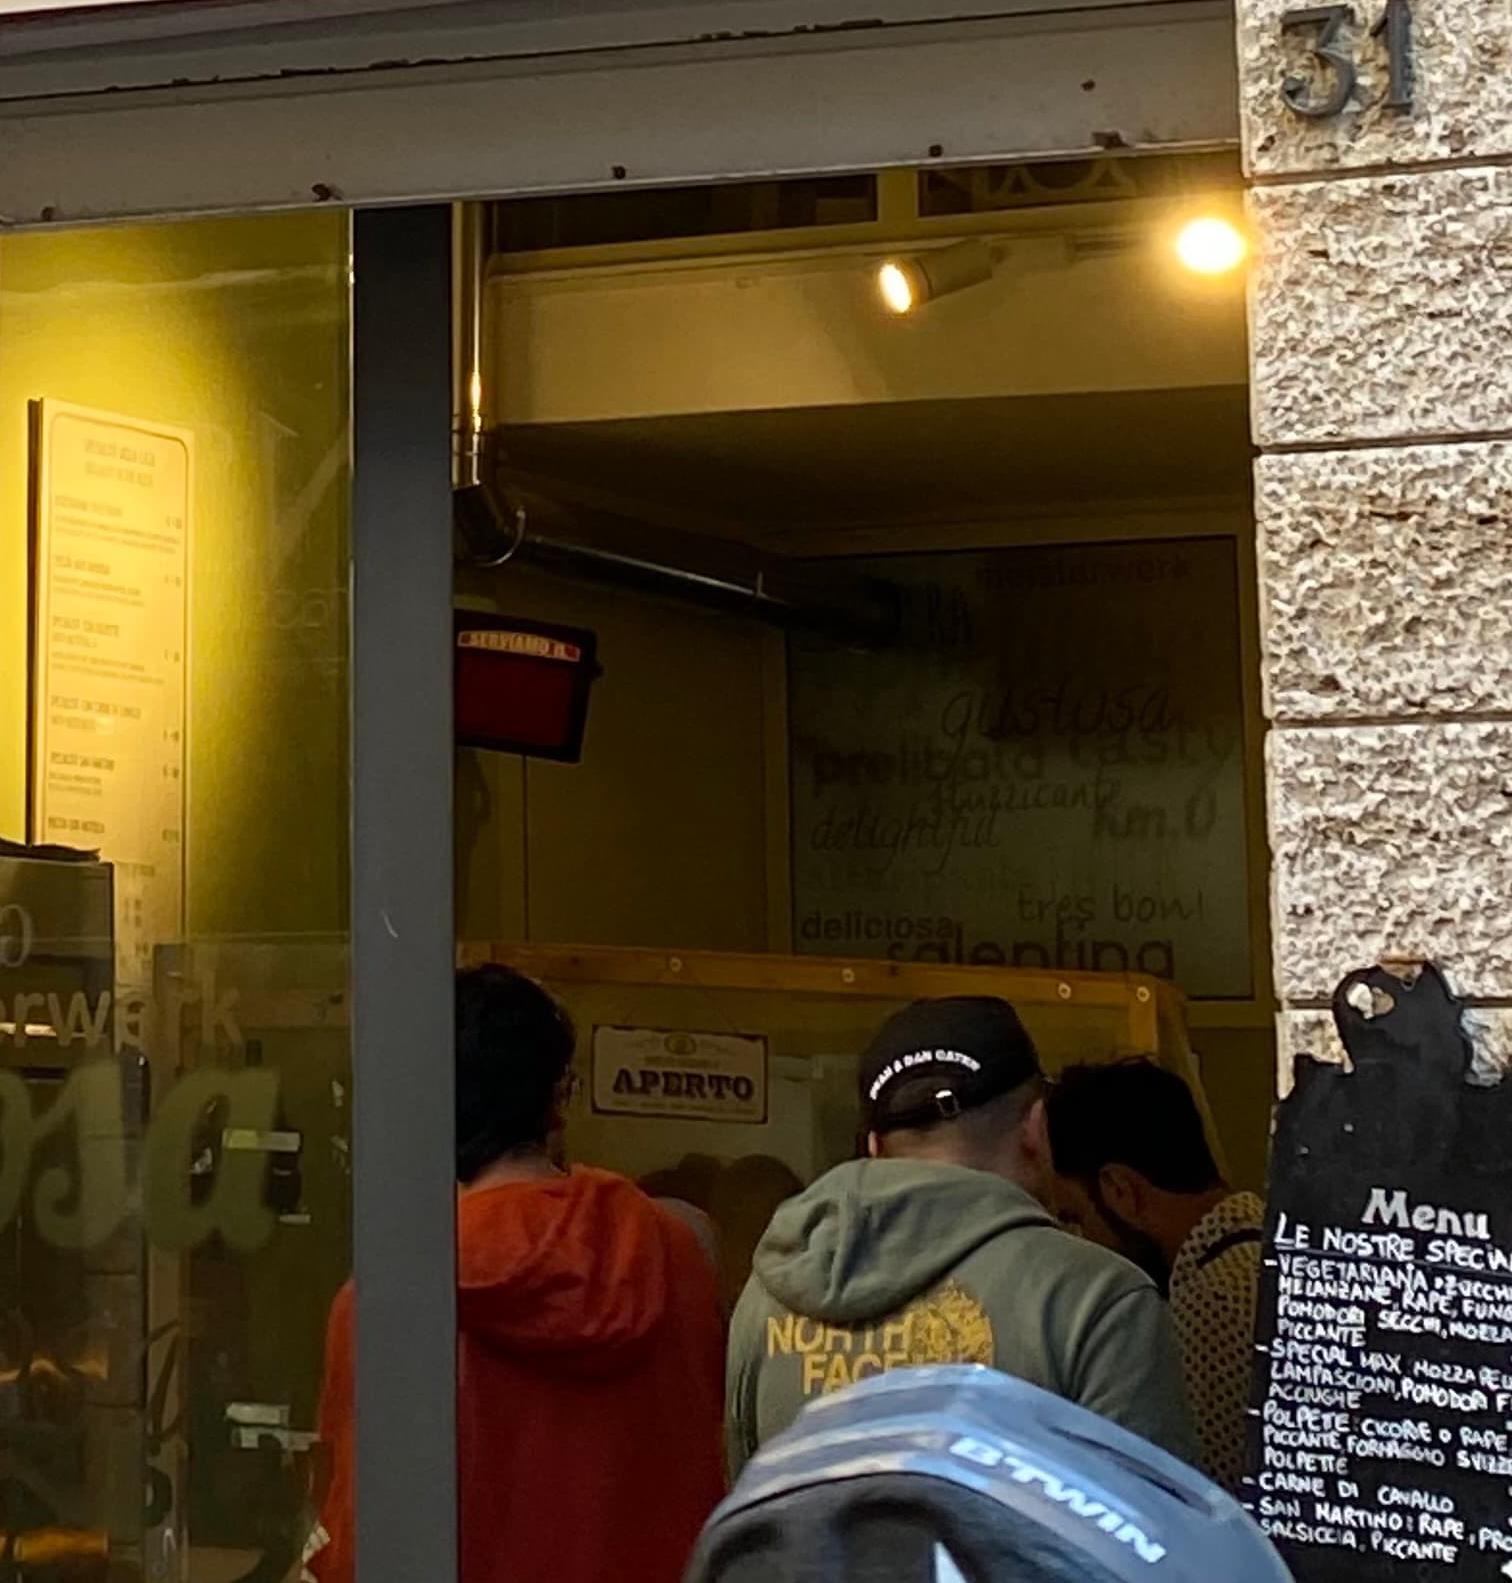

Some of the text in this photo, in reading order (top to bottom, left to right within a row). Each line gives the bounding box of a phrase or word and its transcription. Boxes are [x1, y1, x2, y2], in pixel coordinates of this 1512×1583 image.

[799, 905, 955, 942] deliciosa
[612, 1068, 755, 1102] APERTO
[1360, 1187, 1491, 1240] Menu
[1273, 1211, 1311, 1250] LE
[1322, 1225, 1416, 1262] NOSTRE
[1258, 1471, 1326, 1498] CARNE
[1337, 1479, 1359, 1498] DI
[1259, 1495, 1301, 1518] SAN
